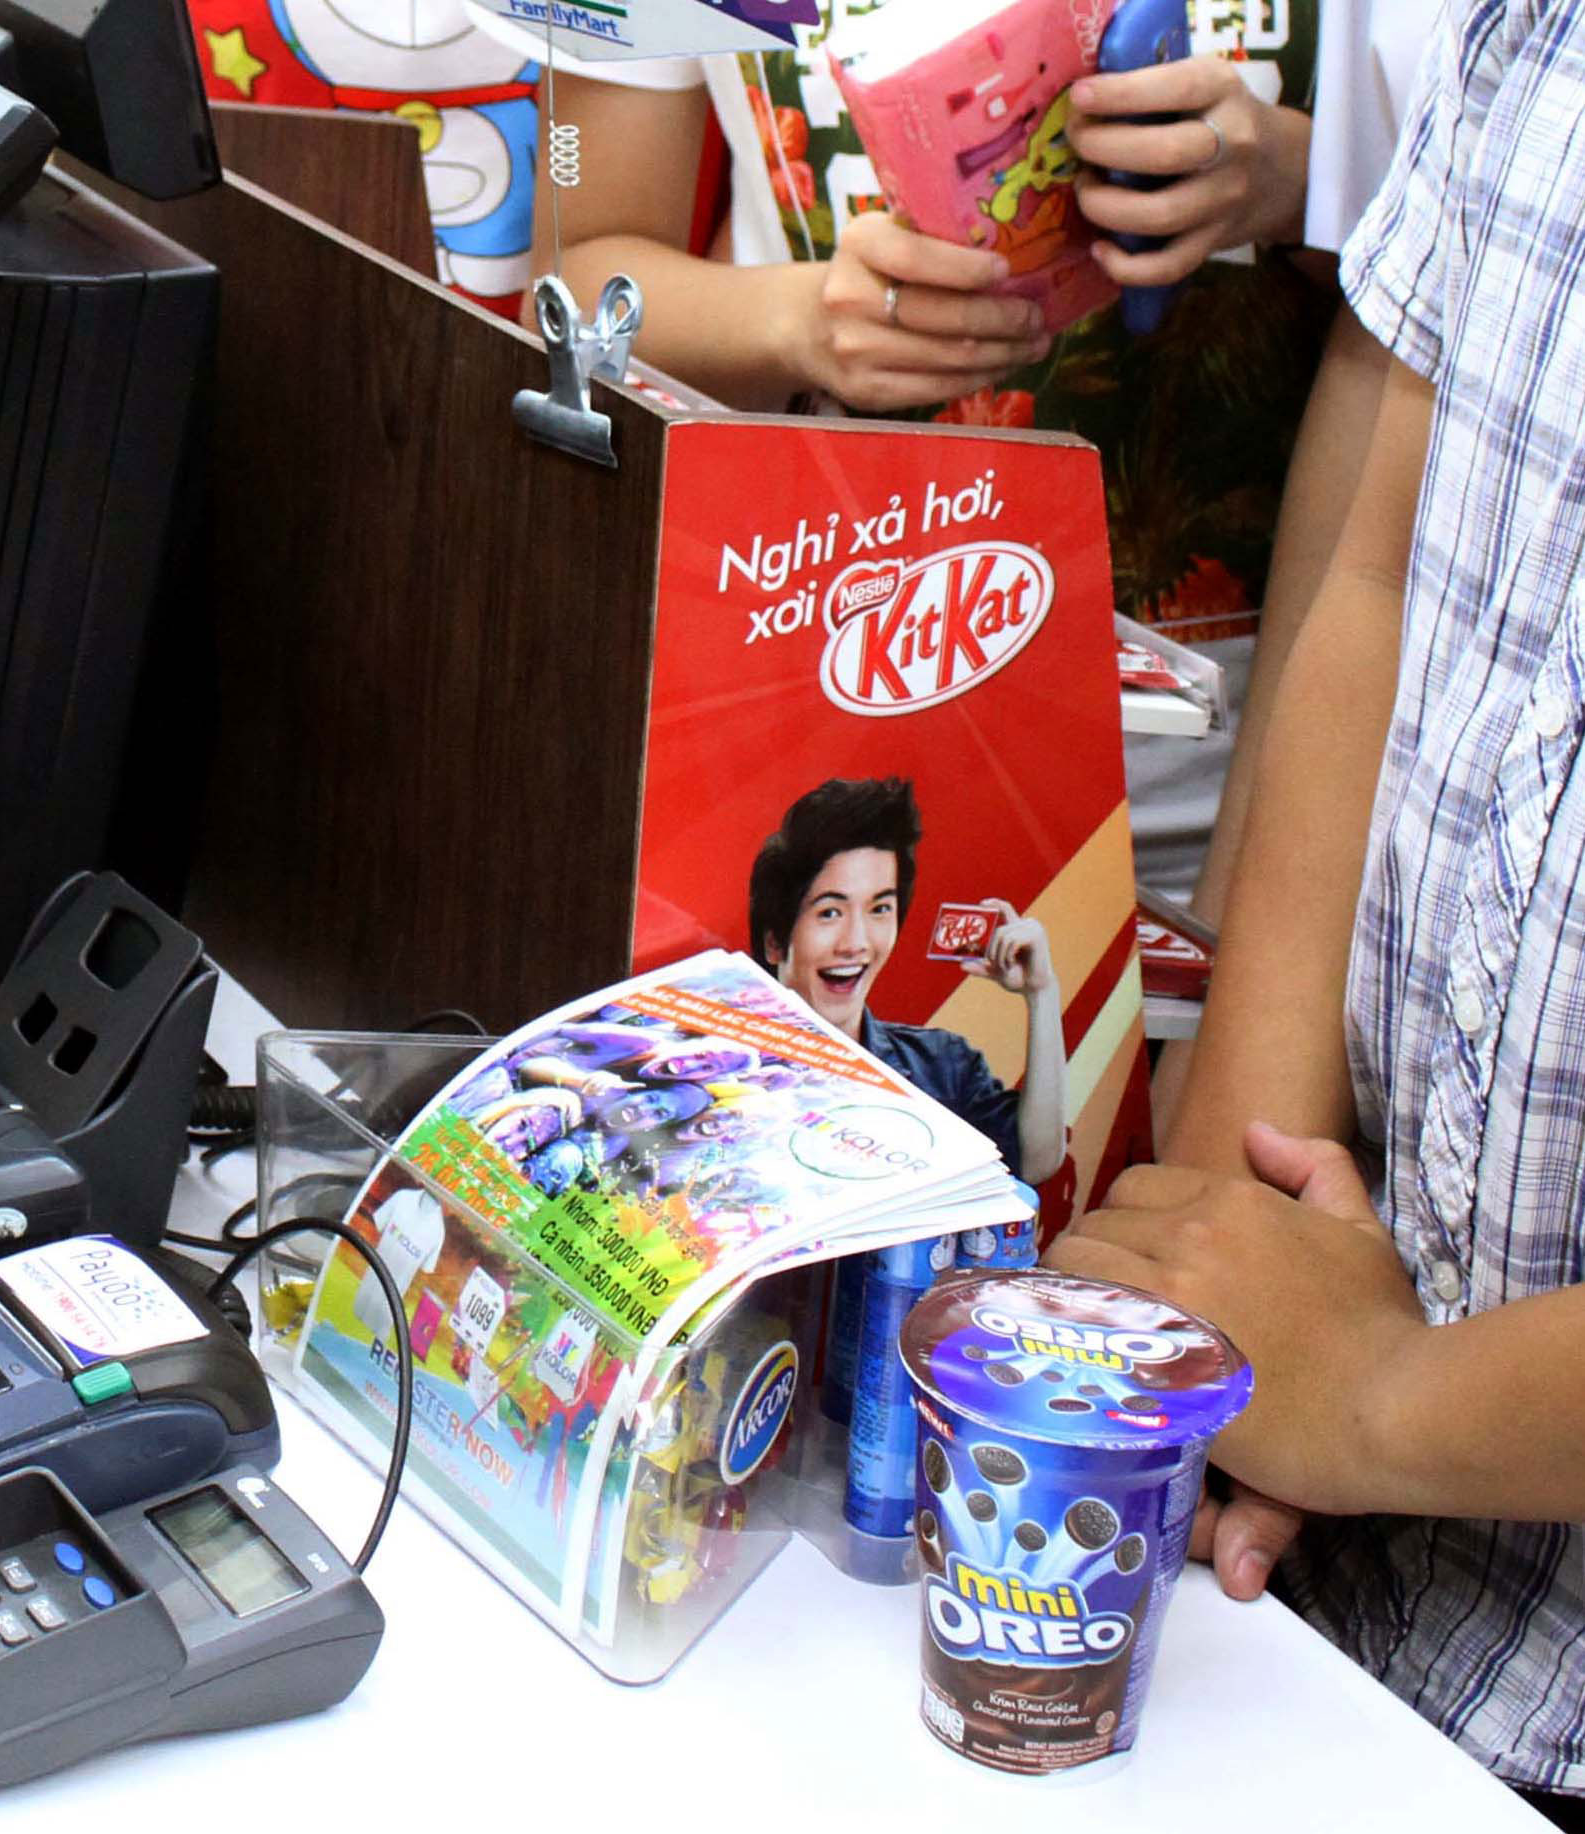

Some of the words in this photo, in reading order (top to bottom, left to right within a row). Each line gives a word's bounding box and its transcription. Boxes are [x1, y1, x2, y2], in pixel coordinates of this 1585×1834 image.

[510, 0, 620, 38] FamilyMart
[718, 512, 840, 592] Nghỉ
[849, 494, 907, 553] xả
[921, 469, 1005, 533] hơi,
[745, 580, 818, 644] xơi
[857, 555, 1031, 700] KitKat
[831, 1127, 929, 1175] KOLOR
[69, 1249, 141, 1306] Payoo
[584, 1263, 632, 1313] 350,000
[597, 1227, 644, 1274] 300,000
[638, 1264, 669, 1296] VNĐ
[465, 1294, 495, 1331] 1099
[979, 1312, 1177, 1359] OREO
[542, 1350, 576, 1389] KOLOR
[1021, 1338, 1123, 1371] mini
[369, 1338, 462, 1442] RESTER
[464, 1429, 514, 1486] NOW
[729, 1369, 794, 1463] ARCOR
[957, 1563, 1078, 1617] mini
[929, 1585, 1125, 1656] OREO
